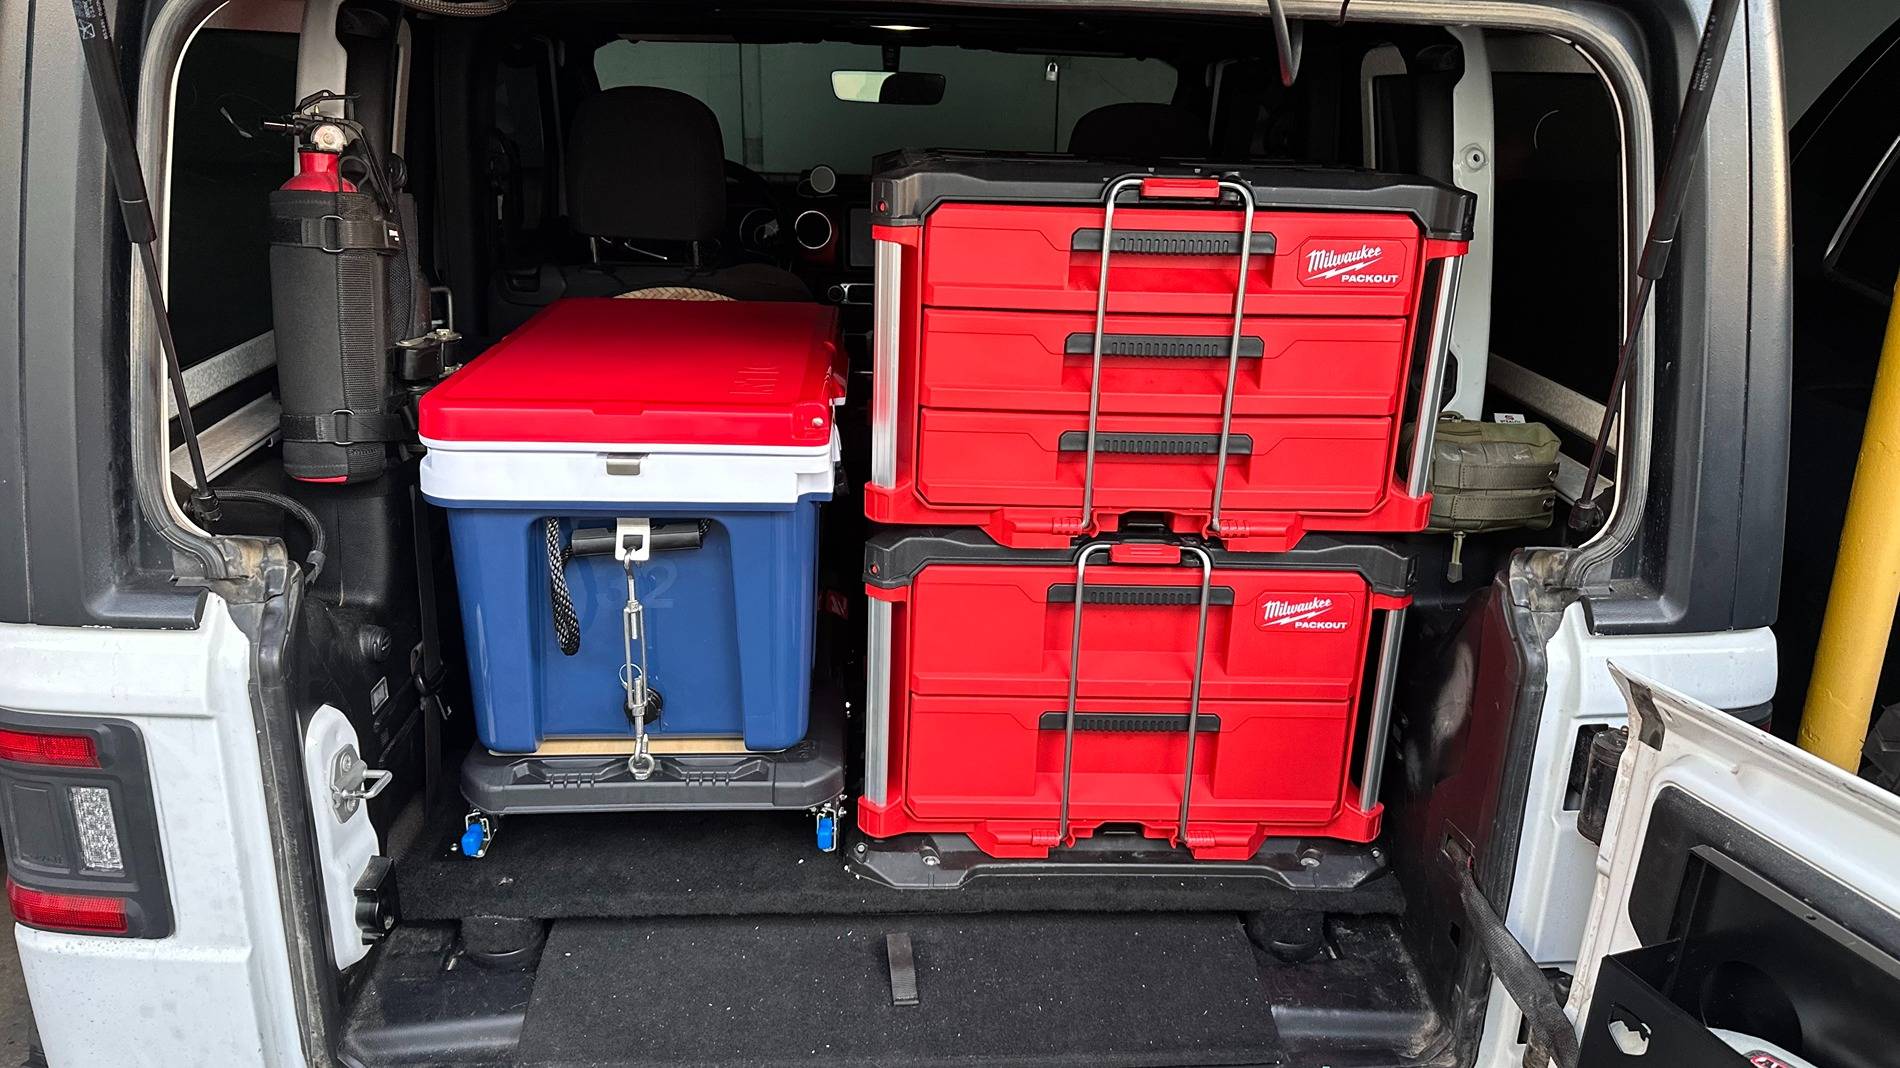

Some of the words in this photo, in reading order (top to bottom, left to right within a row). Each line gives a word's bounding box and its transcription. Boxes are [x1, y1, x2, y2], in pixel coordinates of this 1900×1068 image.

[1305, 244, 1383, 273] Milwaukee
[1341, 274, 1399, 283] PACKOUT
[1261, 596, 1333, 621] Milwaukee
[1294, 621, 1348, 630] PACKOUT
